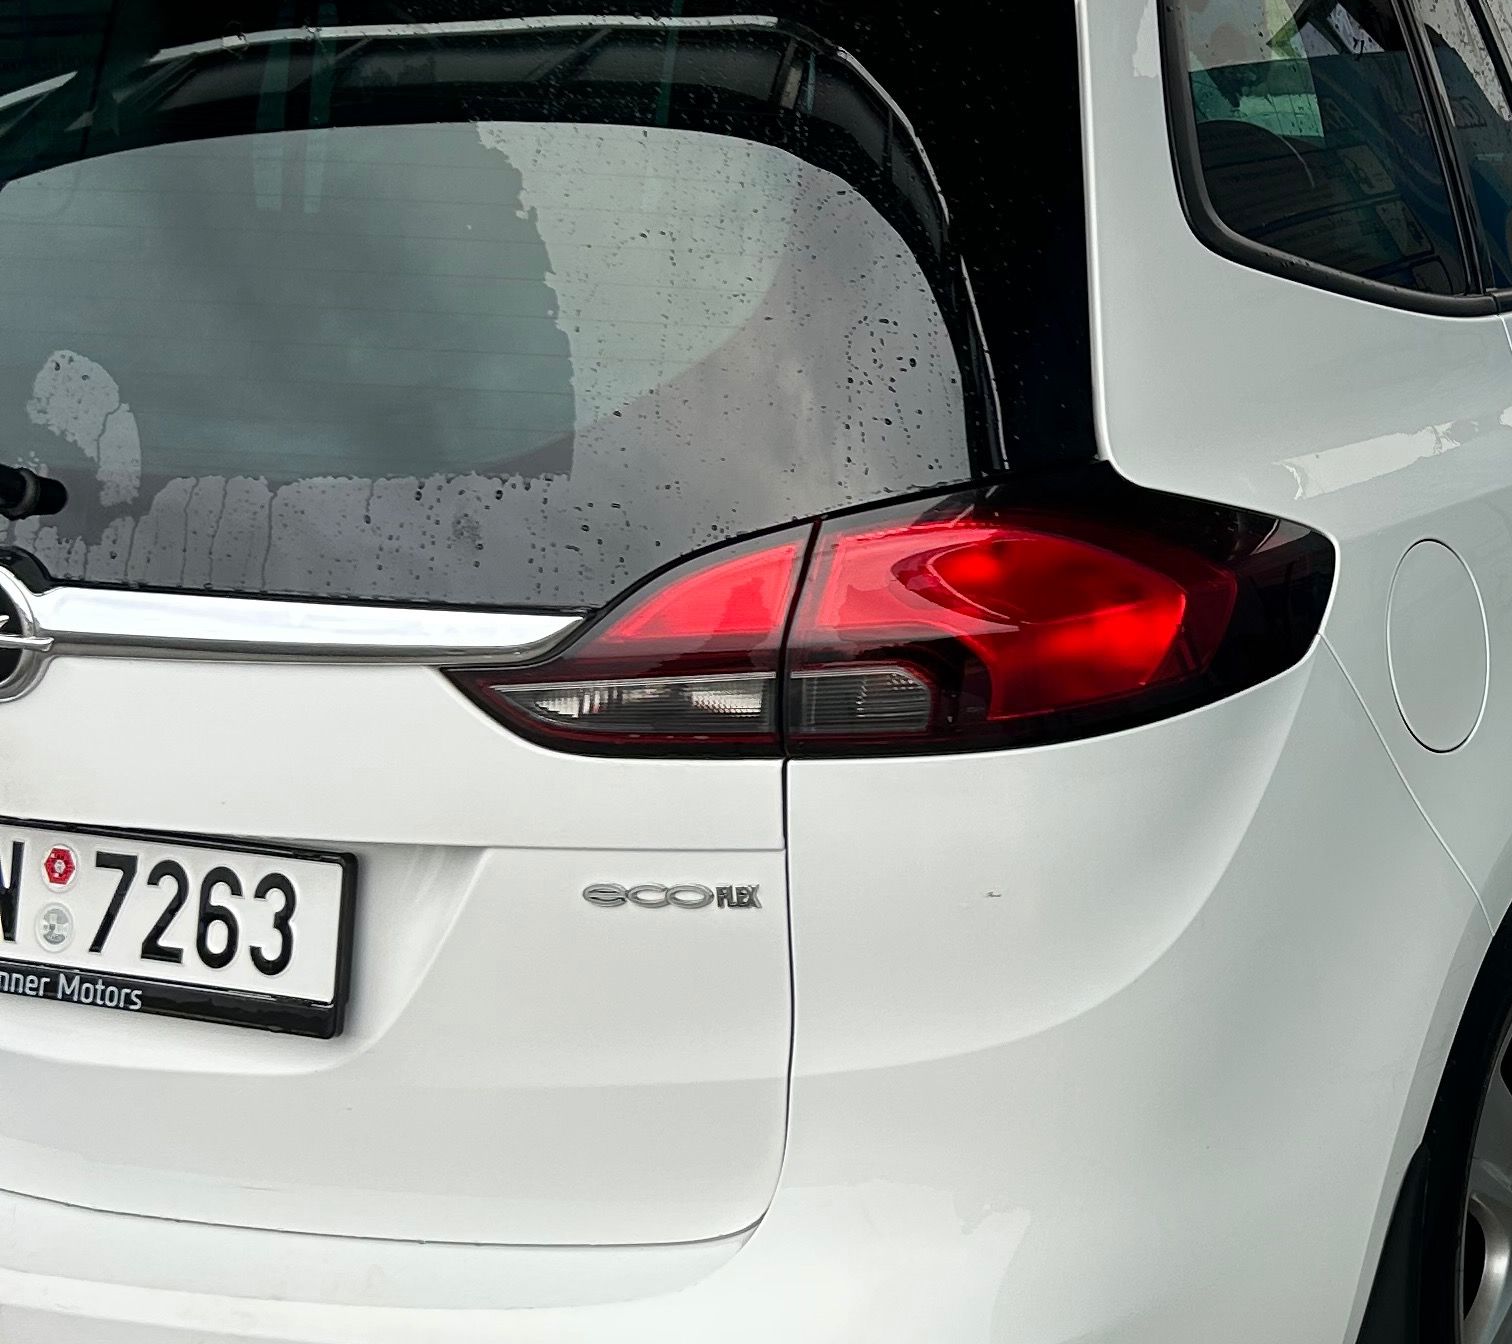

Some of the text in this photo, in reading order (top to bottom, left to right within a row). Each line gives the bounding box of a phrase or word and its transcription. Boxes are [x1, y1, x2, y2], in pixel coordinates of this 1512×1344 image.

[89, 850, 296, 977] 7263
[0, 971, 143, 1011] nner Motors
